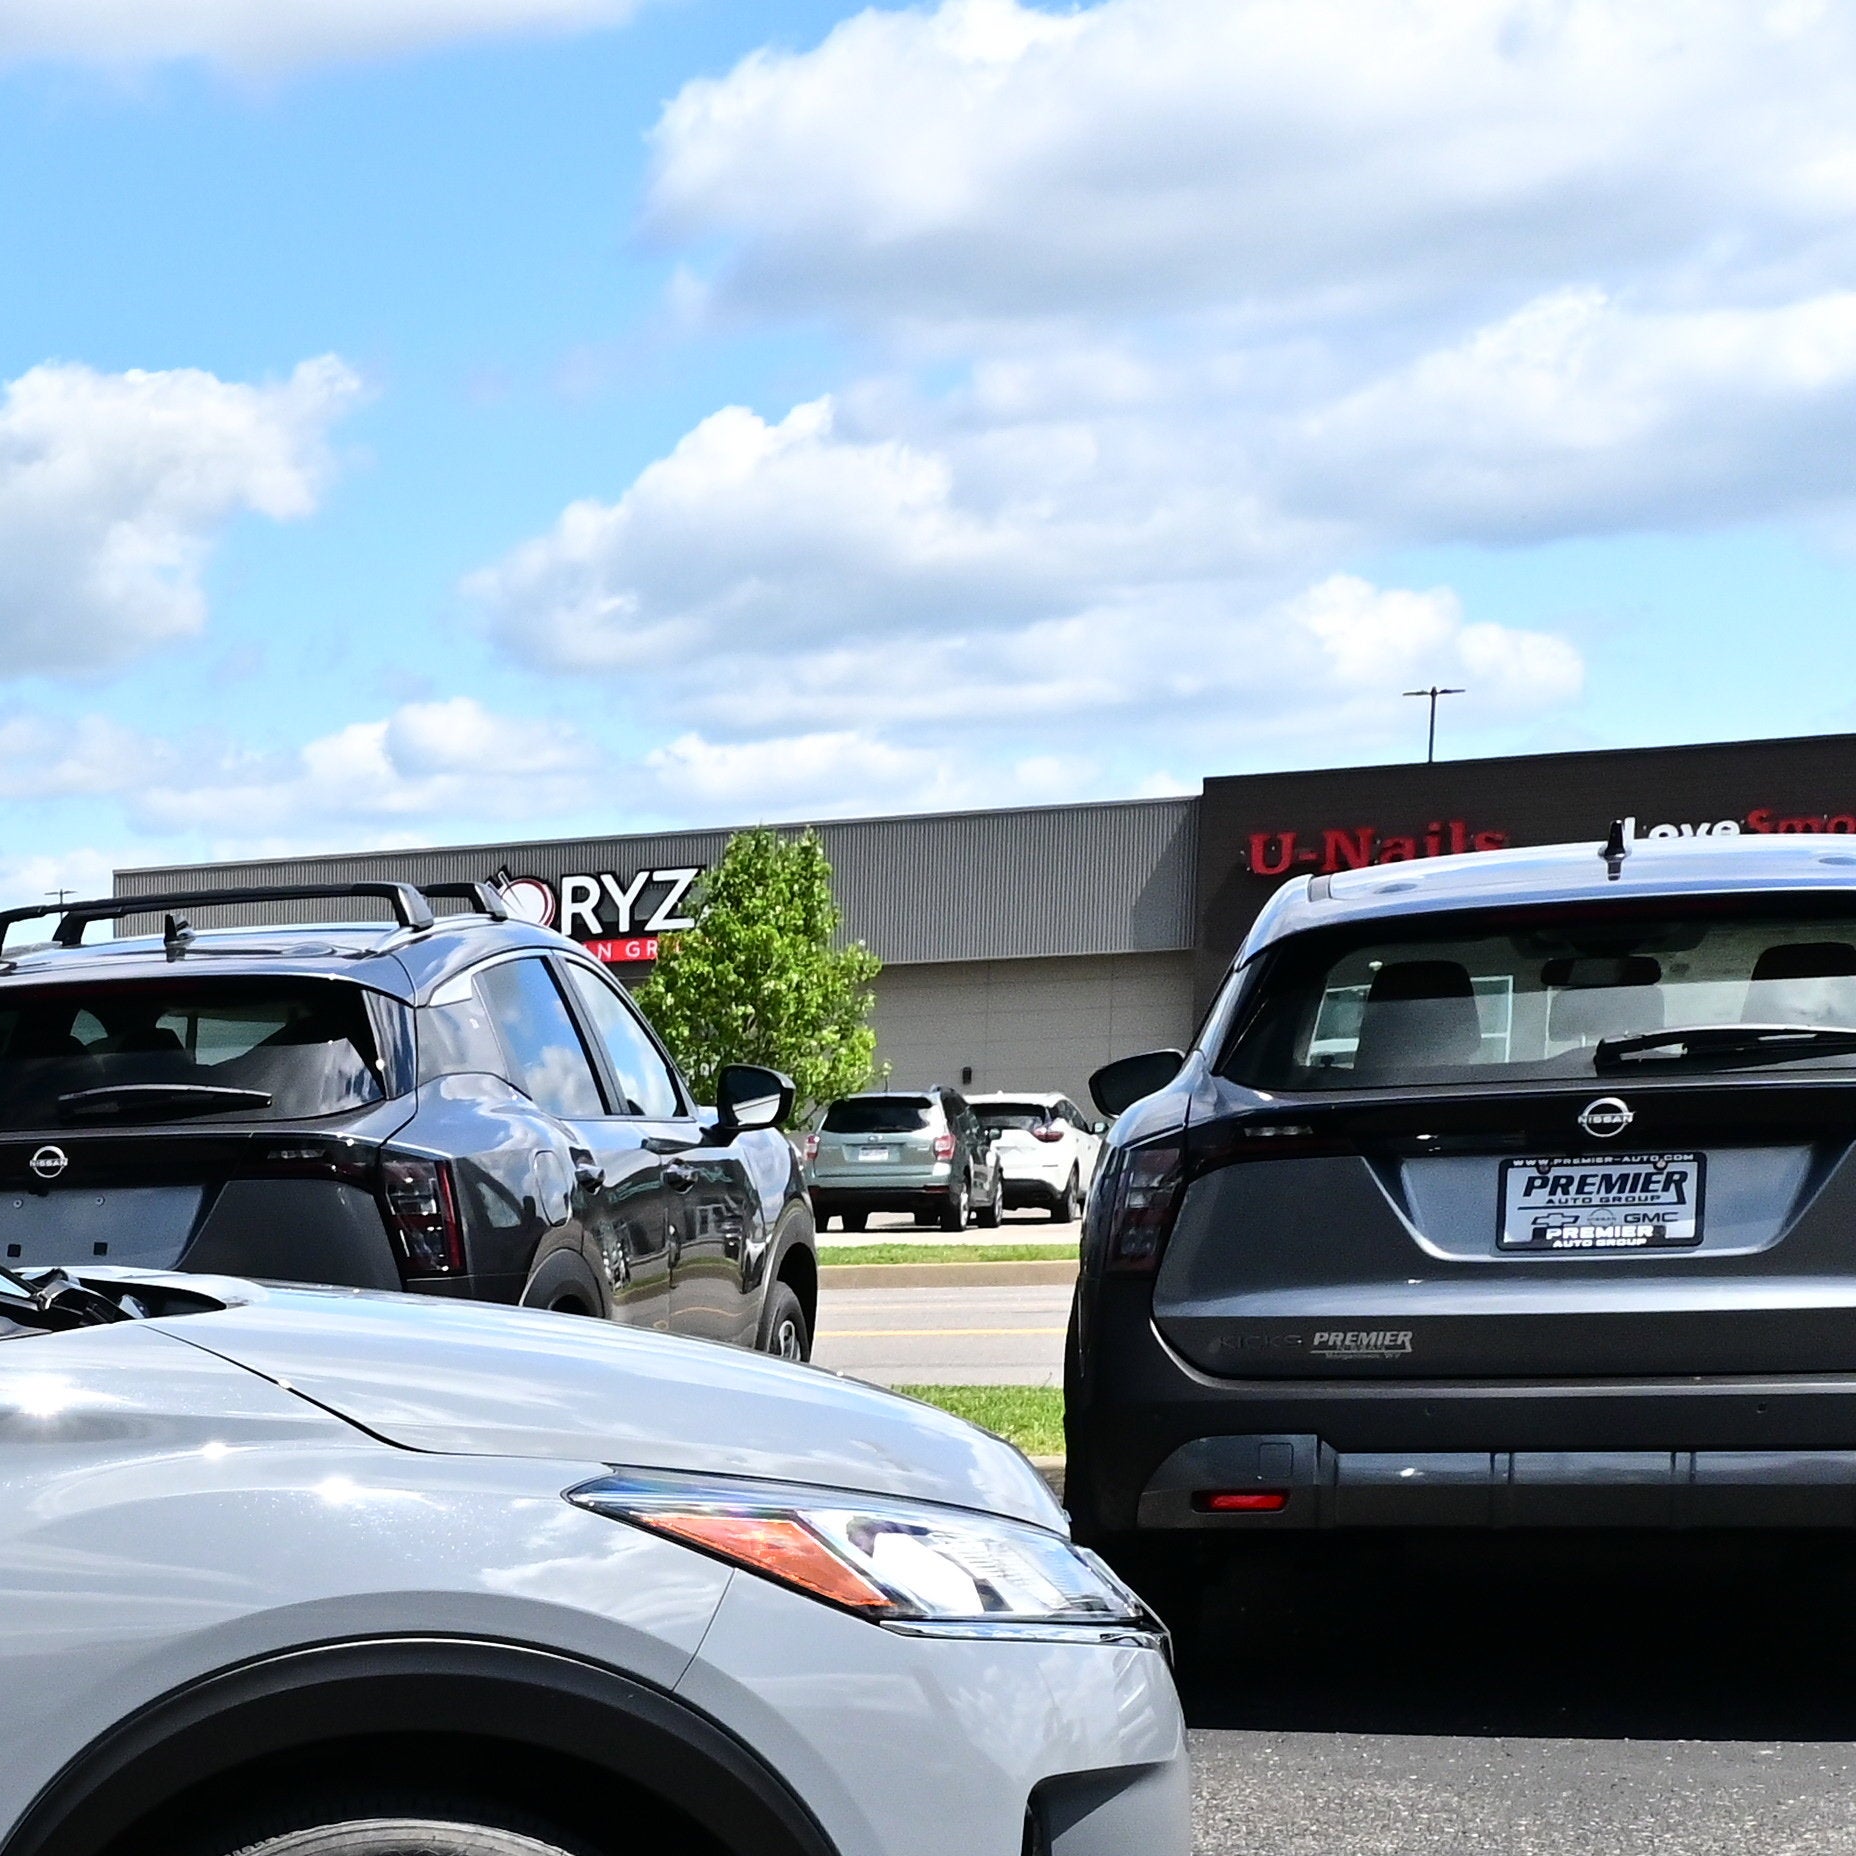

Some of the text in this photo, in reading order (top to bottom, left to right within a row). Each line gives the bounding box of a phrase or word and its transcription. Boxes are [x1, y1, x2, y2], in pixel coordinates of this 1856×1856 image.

[1248, 819, 1508, 876] U-Nails
[1577, 1112, 1635, 1124] NISSAN
[29, 1157, 68, 1168] NISSAN
[1523, 1170, 1688, 1203] PREMIER
[1545, 1194, 1661, 1205] AUTO GROUP
[1623, 1211, 1679, 1224] GMC
[1546, 1225, 1654, 1240] PREMIER
[1552, 1237, 1648, 1248] AUTO GROUP
[1313, 1331, 1413, 1350] PREMIER
